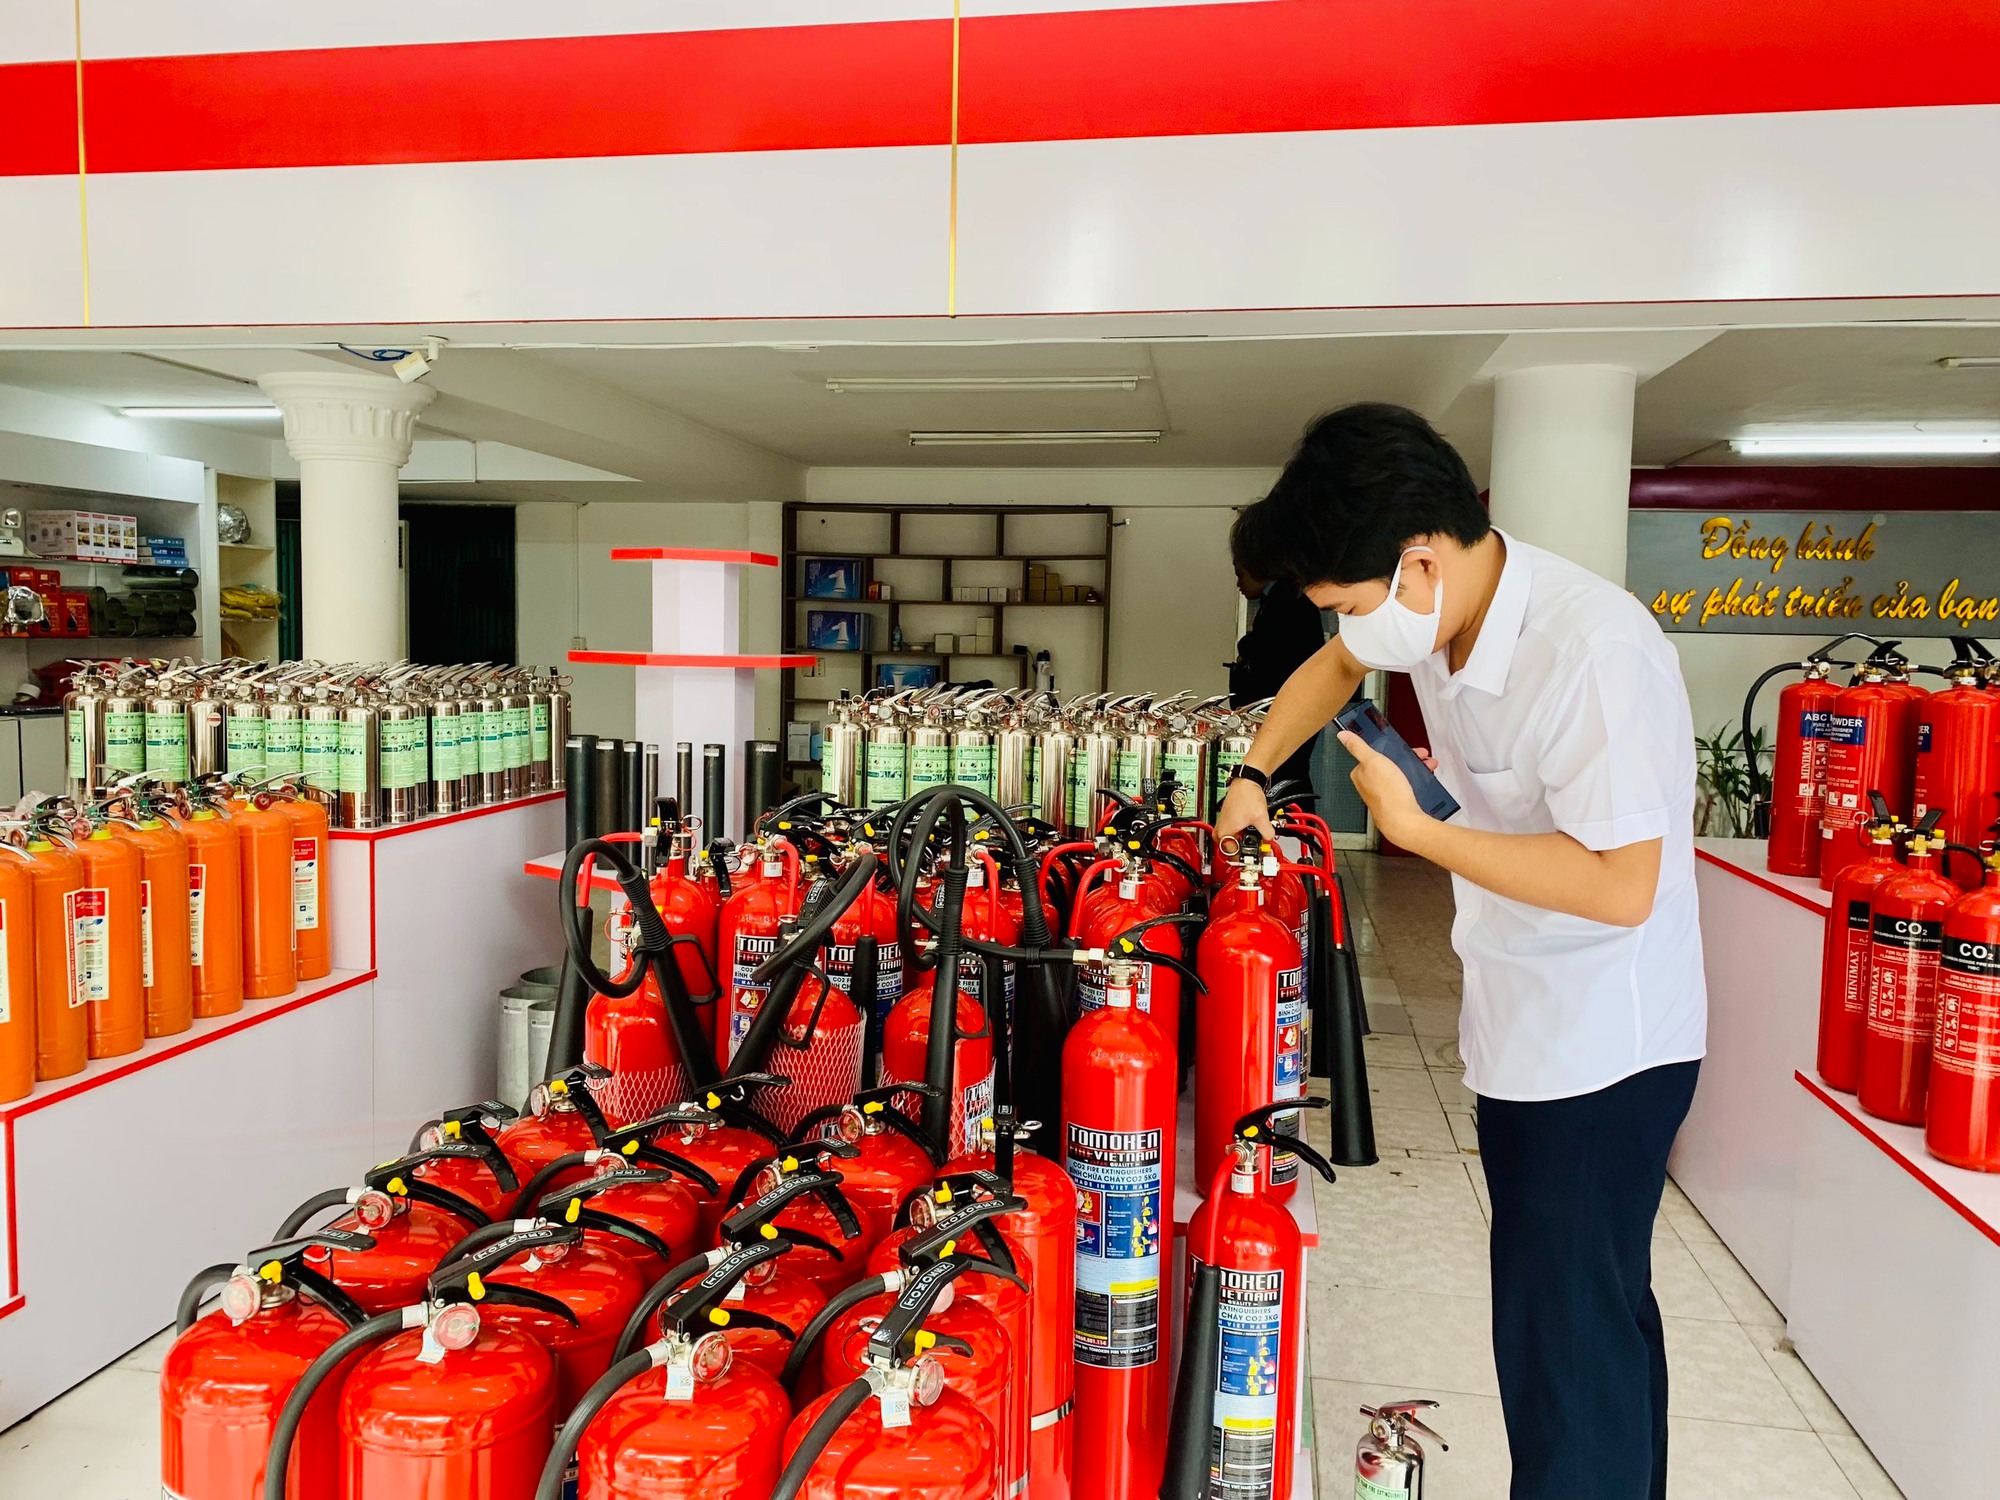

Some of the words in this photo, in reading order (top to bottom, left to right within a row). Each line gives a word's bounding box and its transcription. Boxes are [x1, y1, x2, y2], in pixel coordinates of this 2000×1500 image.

[1701, 516, 1789, 574] Đồng
[1797, 521, 1877, 560] hành
[1652, 589, 1697, 624] sự
[1699, 577, 1781, 627] phát
[1785, 576, 1862, 618] triển
[1872, 580, 1931, 618] của
[1939, 578, 2000, 629] bạn
[1804, 713, 1828, 721] ABC
[1832, 717, 1863, 728] OWDER
[1801, 740, 1812, 780] MINIMAX
[1848, 950, 1860, 1001] MINIMAX
[1869, 966, 1880, 1019] MINIMAX
[1093, 1149, 1159, 1163] VIETNAM
[1073, 1161, 1086, 1170] CO2
[1086, 1165, 1100, 1174] FIRE
[1101, 1166, 1153, 1176] EXTINGUISHERS
[1074, 1177, 1094, 1188] MADE
[1132, 1182, 1150, 1190] NAM
[1125, 1175, 1143, 1183] CO2
[1143, 1172, 1158, 1182] 5KG
[1221, 1289, 1278, 1302] IETNAM
[1227, 1321, 1246, 1329] VIET
[1264, 1313, 1279, 1322] 3KG
